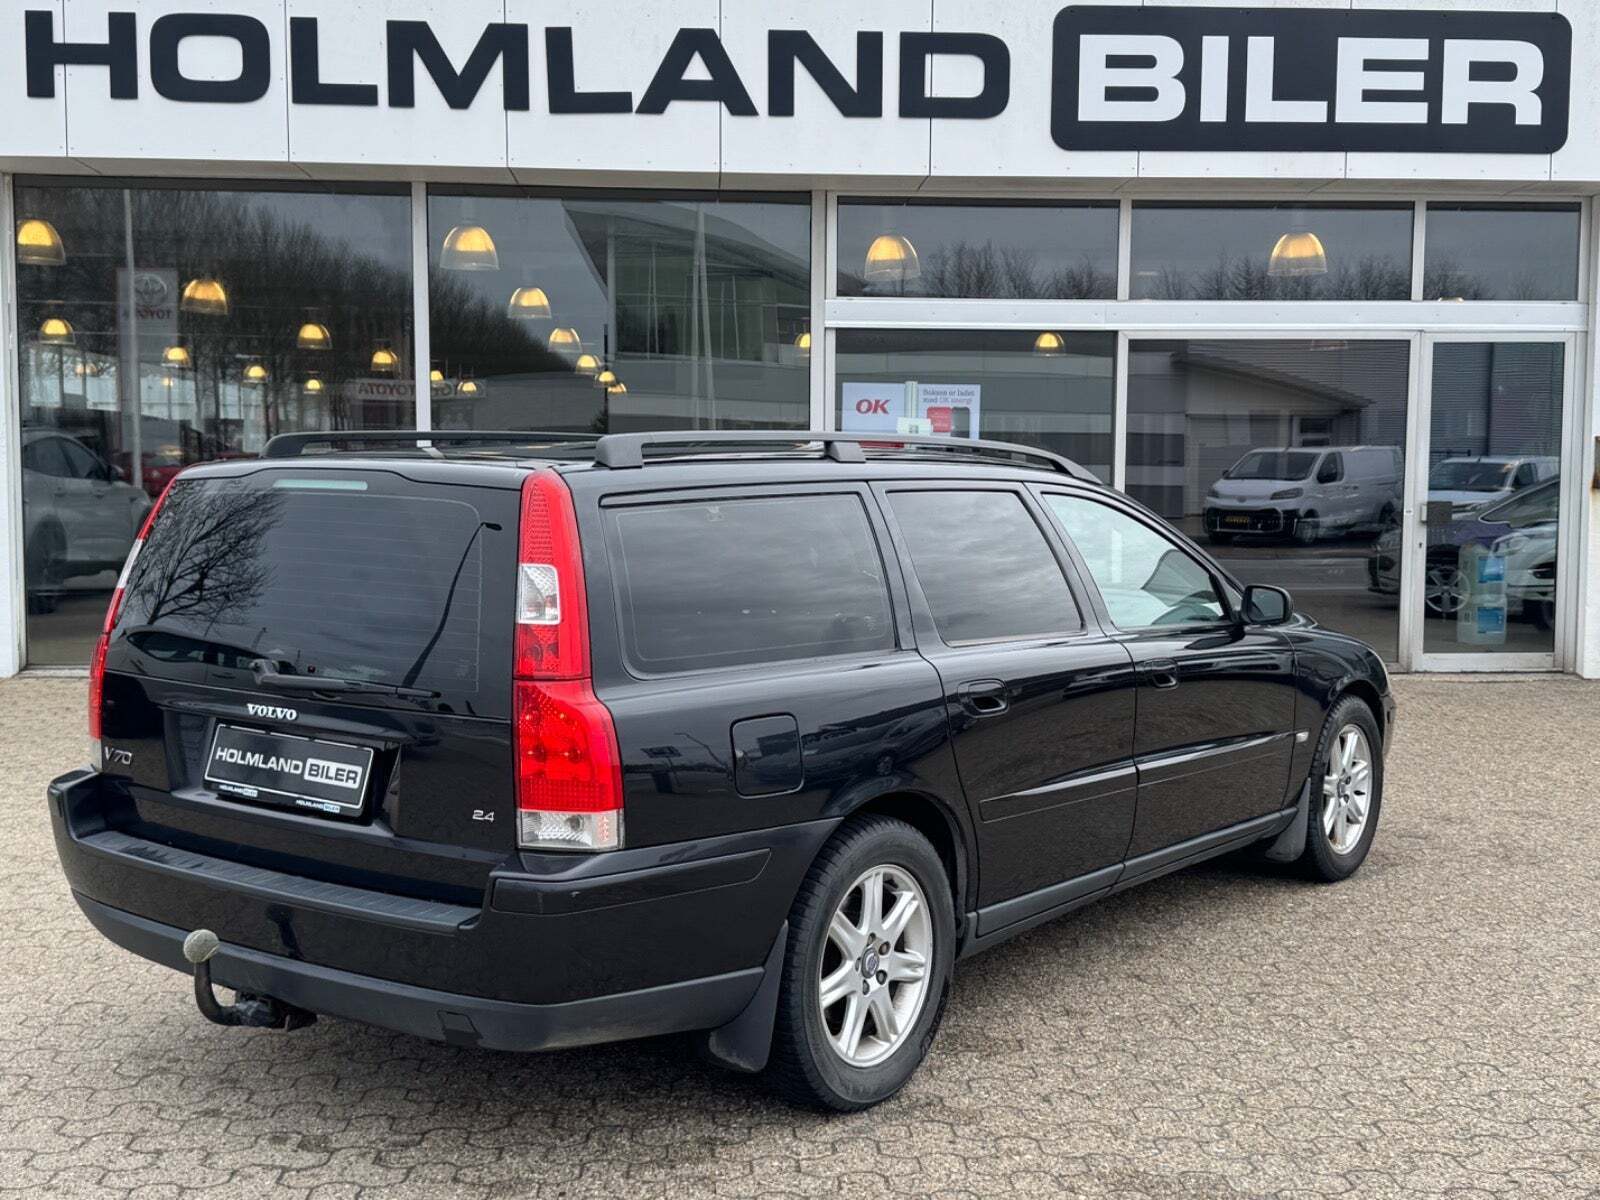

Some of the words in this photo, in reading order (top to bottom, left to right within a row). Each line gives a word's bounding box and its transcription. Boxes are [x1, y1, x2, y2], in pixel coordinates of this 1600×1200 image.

[24, 9, 1010, 119] HOLMLAND
[1077, 33, 1545, 126] BILER
[855, 398, 891, 415] OK
[246, 703, 297, 720] VOLVO
[104, 746, 133, 766] V70
[215, 746, 303, 775] HOLMLAND
[307, 764, 359, 785] BILER
